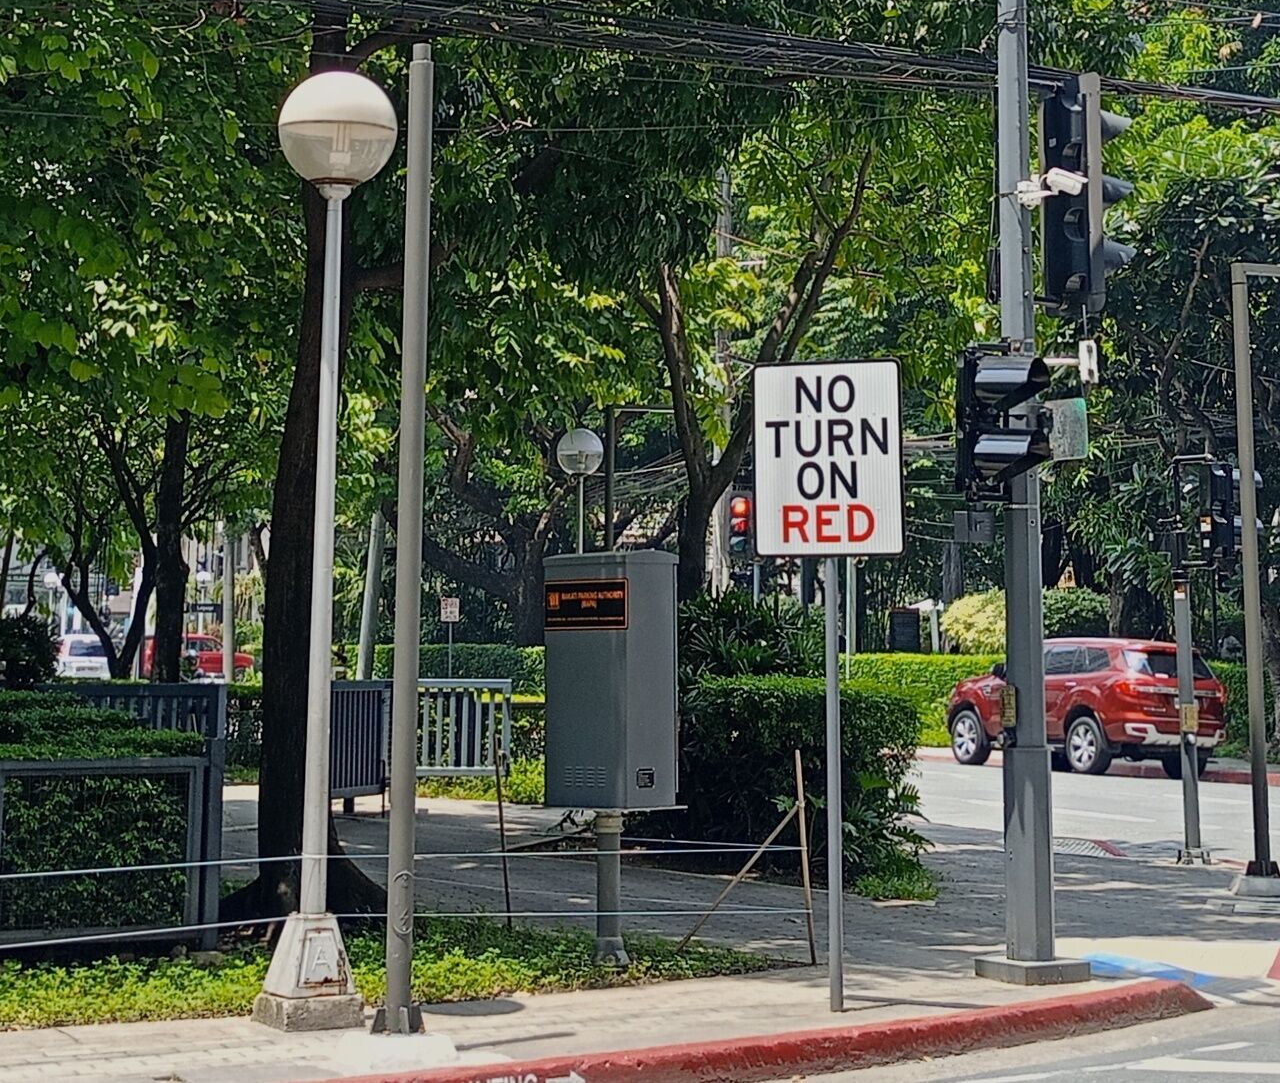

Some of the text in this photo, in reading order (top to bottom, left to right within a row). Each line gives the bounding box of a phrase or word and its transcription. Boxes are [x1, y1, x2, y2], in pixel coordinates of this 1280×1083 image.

[795, 374, 855, 414] NO
[765, 417, 888, 458] TURN
[797, 461, 858, 500] ON
[782, 504, 875, 543] RED
